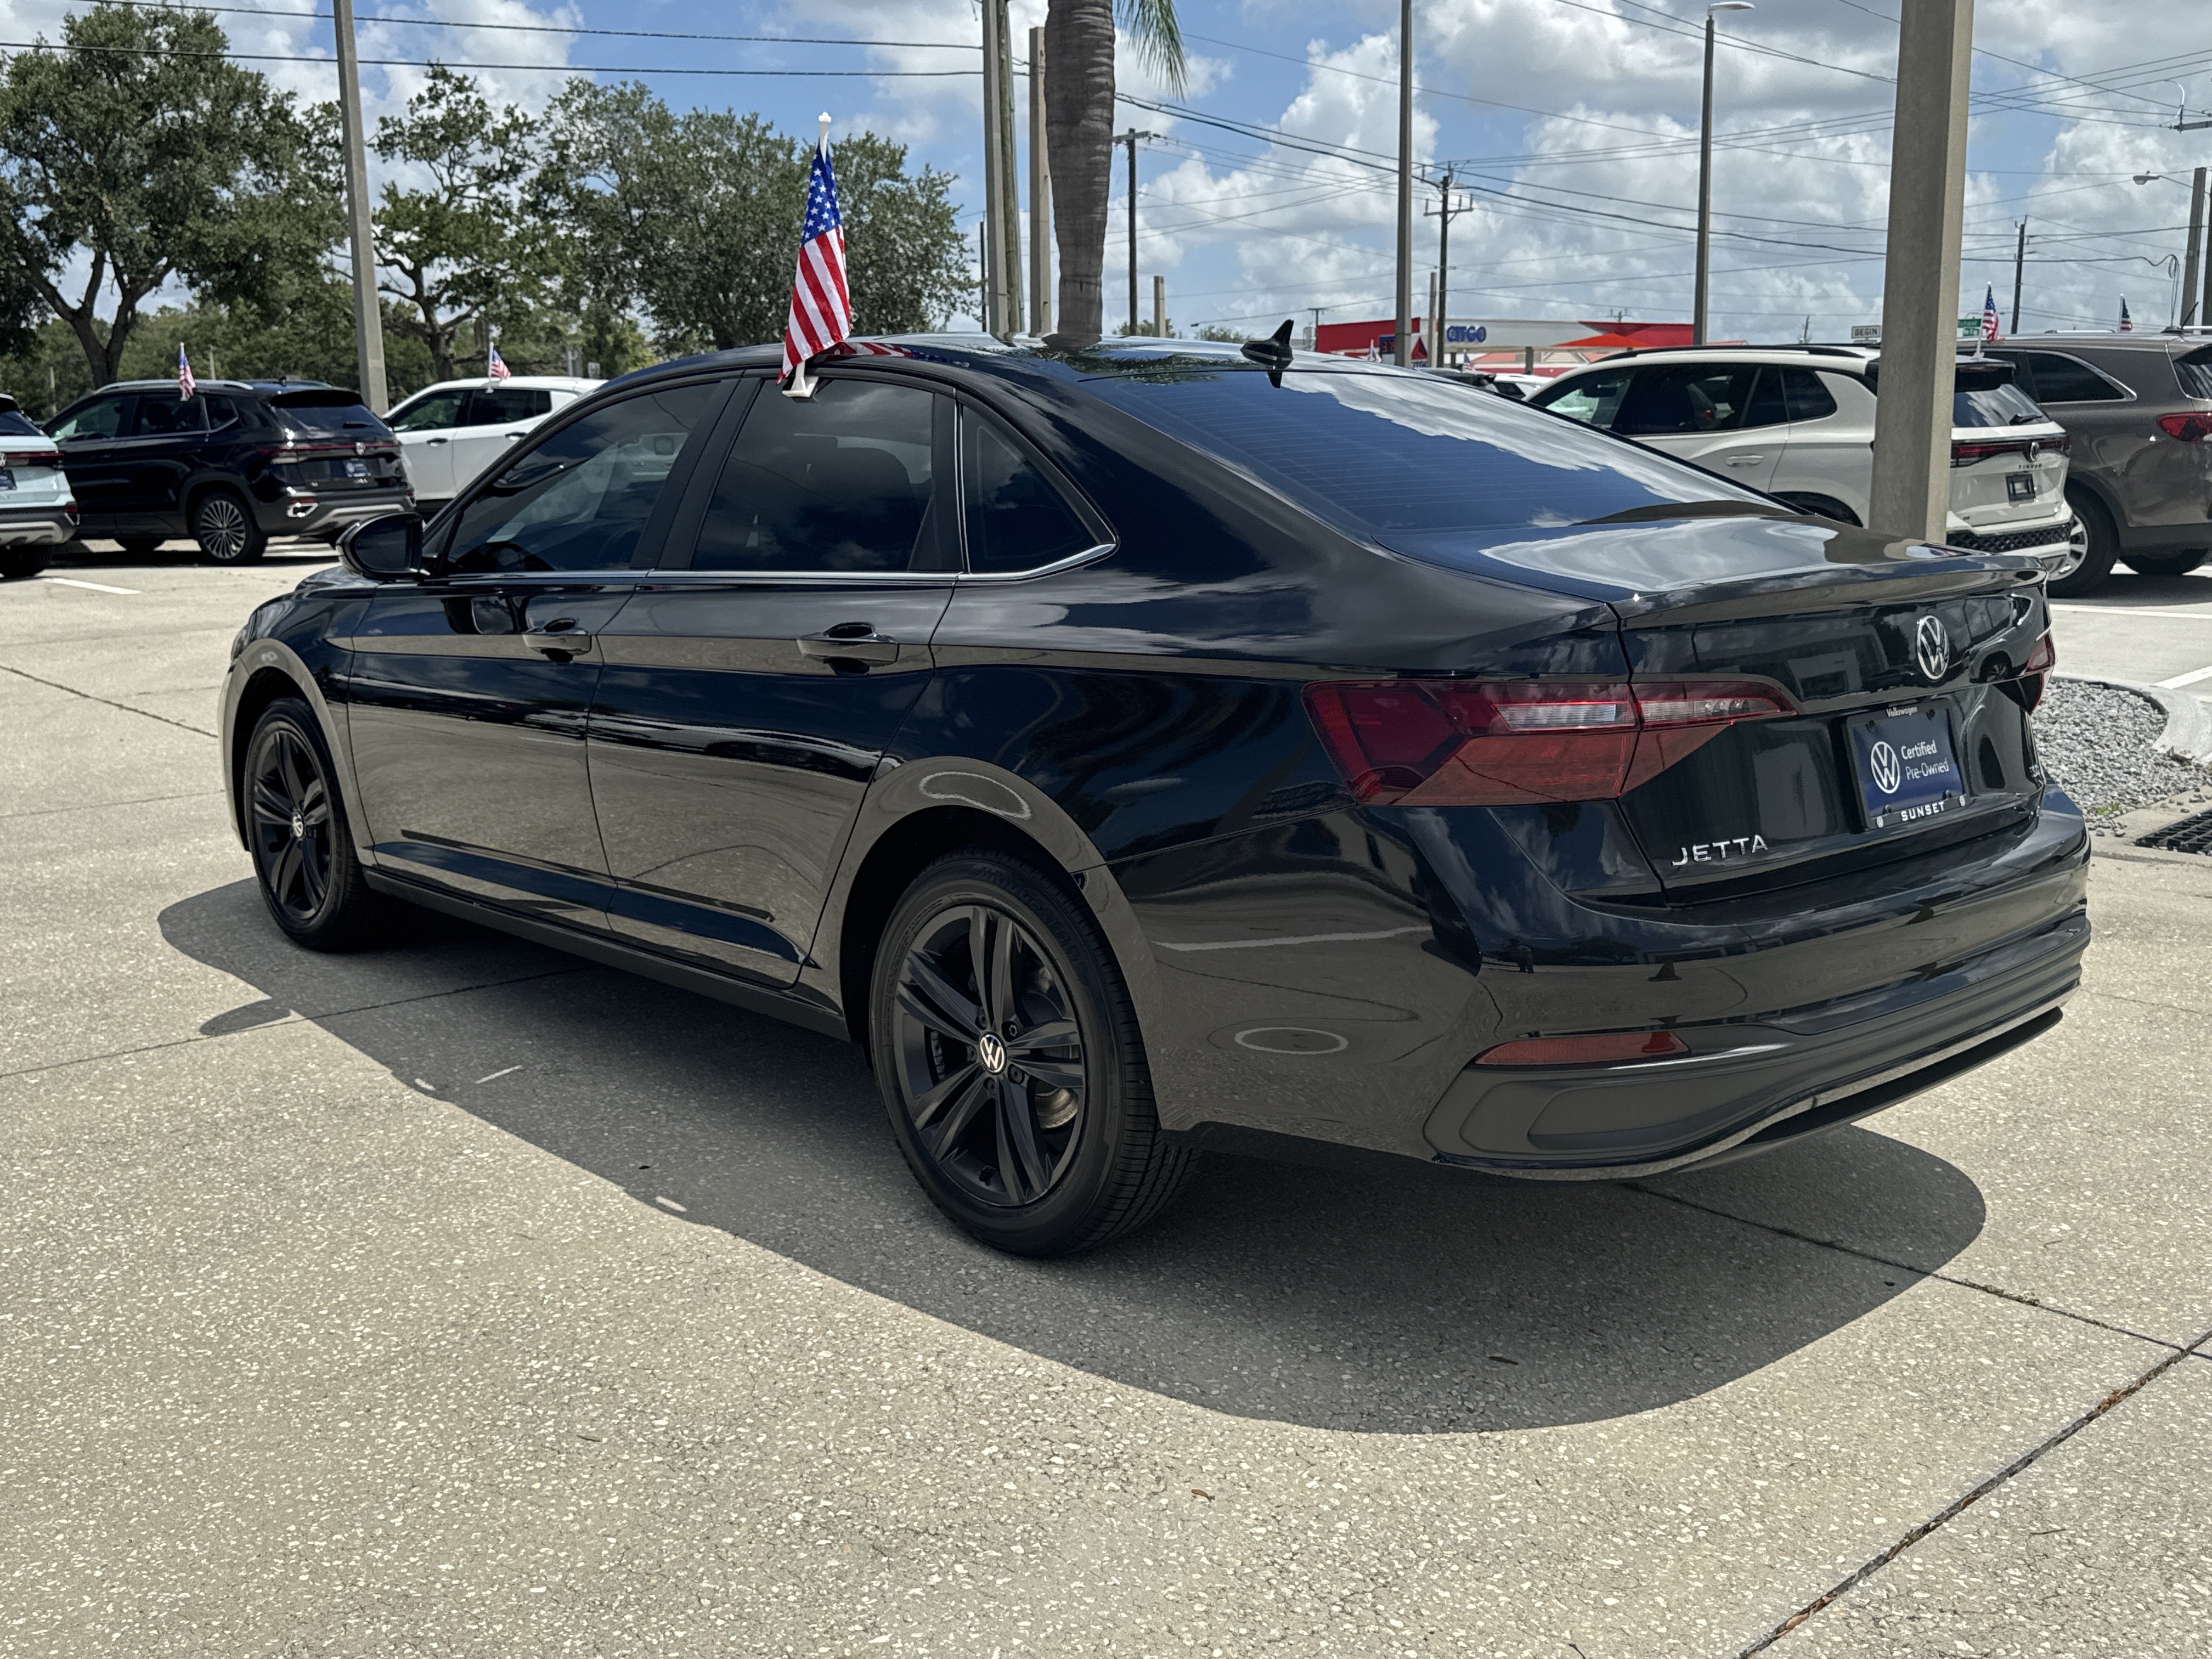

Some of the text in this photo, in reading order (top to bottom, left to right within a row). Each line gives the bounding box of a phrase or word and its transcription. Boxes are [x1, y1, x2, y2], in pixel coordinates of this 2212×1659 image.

[1447, 325, 1487, 343] CITGO
[1886, 707, 1918, 718] Volkswagen
[1900, 740, 1938, 760] Certified
[1905, 758, 1950, 781] Pre-Owned
[1900, 802, 1945, 822] SUNSET
[1672, 834, 1769, 866] JETTA
